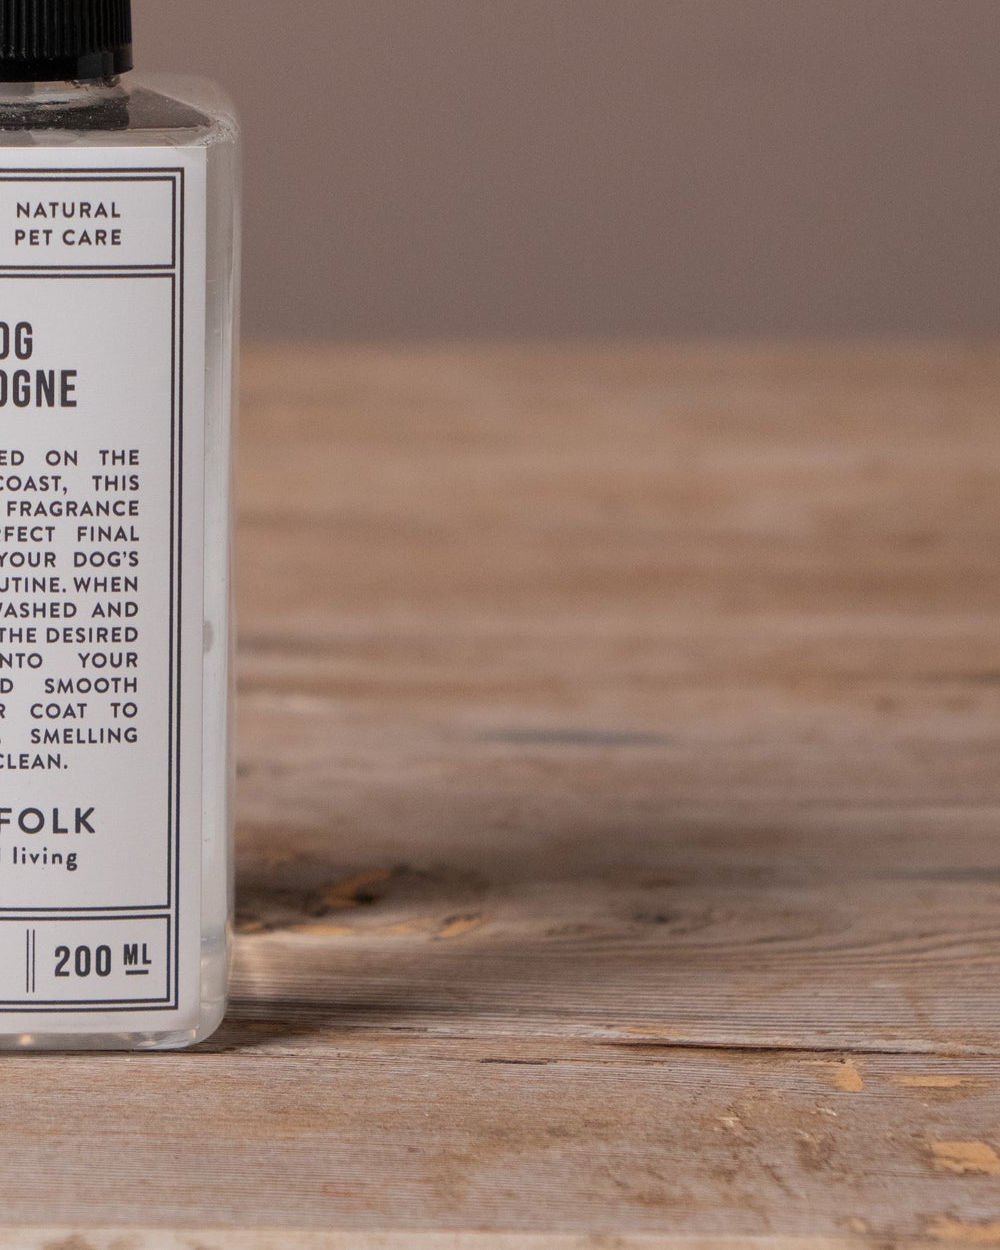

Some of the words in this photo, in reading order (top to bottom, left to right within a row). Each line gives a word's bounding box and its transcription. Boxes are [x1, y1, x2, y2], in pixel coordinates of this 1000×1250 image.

[16, 201, 121, 219] NATURAL
[14, 229, 53, 246] PET
[62, 228, 122, 246] CARE
[45, 449, 78, 467] ON
[98, 449, 140, 466] THE
[91, 474, 140, 492] THIS
[6, 499, 140, 518] FRAGRANCE
[77, 525, 140, 543] FINAL
[73, 575, 138, 593] WHEN
[91, 601, 139, 619] AND
[46, 626, 139, 644] DESIRED
[77, 651, 139, 669] YOUR
[44, 676, 138, 695] SMOOTH
[29, 702, 88, 720] COAT
[109, 701, 138, 719] TO
[30, 726, 138, 745] SMELLING
[12, 846, 78, 872] living
[54, 944, 112, 978] 200
[122, 942, 153, 966] ML
